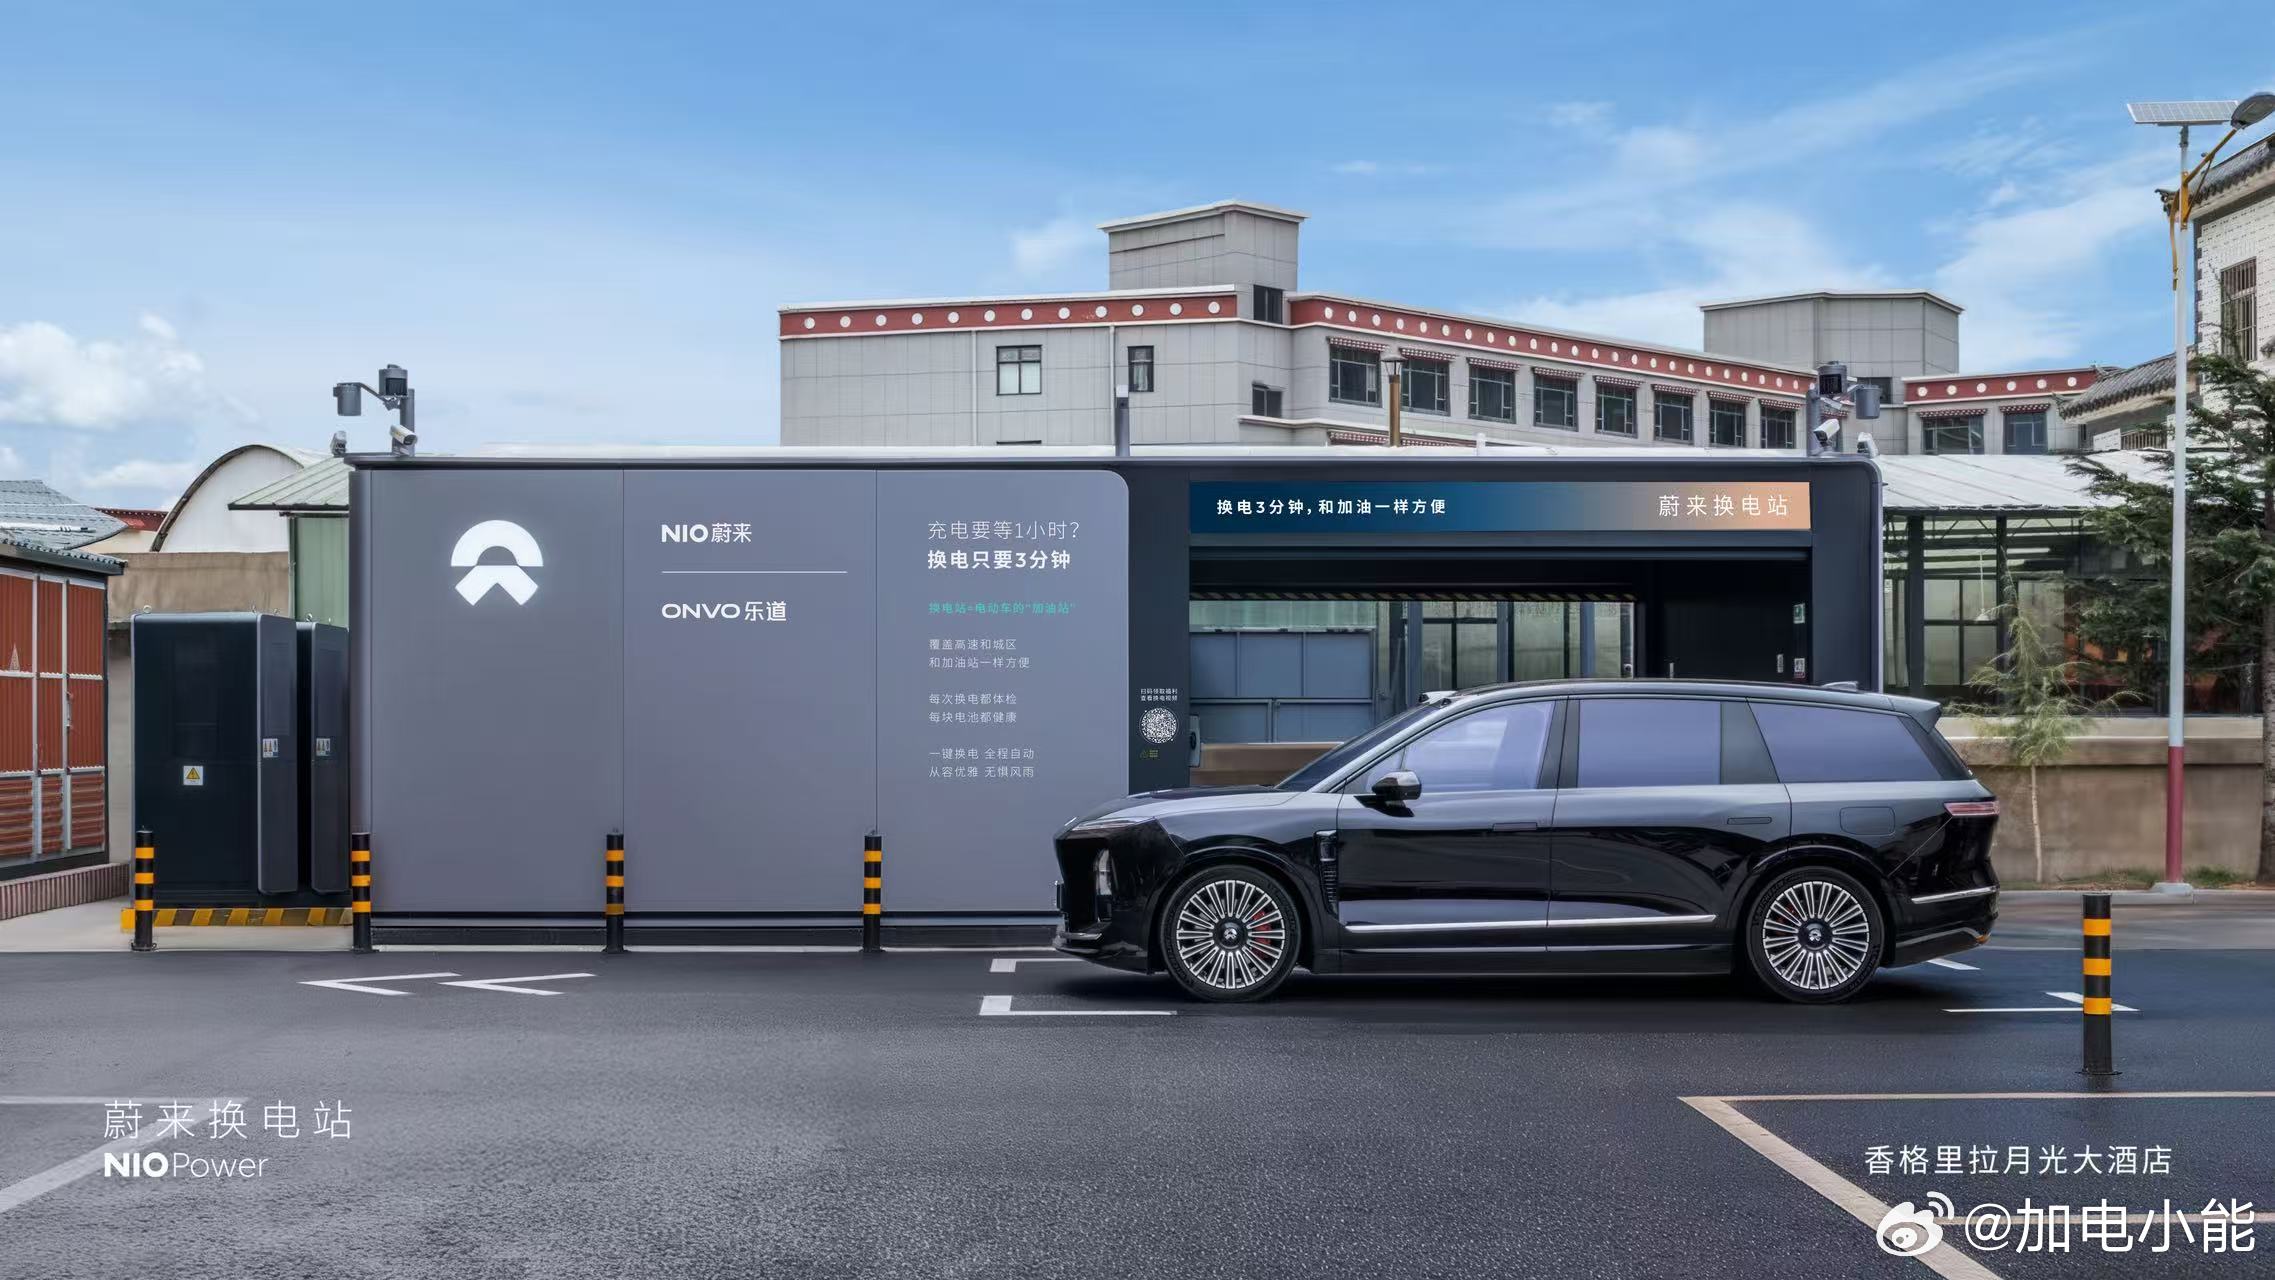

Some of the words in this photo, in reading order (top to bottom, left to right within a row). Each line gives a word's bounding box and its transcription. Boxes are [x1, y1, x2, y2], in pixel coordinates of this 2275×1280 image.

[1658, 494, 1790, 517] 蔚来换电站
[927, 550, 1071, 570] 换电只要3分钟
[929, 638, 1017, 650] 覆盖高速和城区
[928, 656, 1030, 669] 和加油站一样方便
[929, 693, 1017, 705] 每次换电都体检
[929, 711, 1017, 723] 每块电池都健康
[929, 748, 979, 760] 一键换电
[984, 748, 1034, 760] 全程自动
[929, 766, 979, 778] 从容优雅
[984, 766, 1034, 778] 无惧风雨
